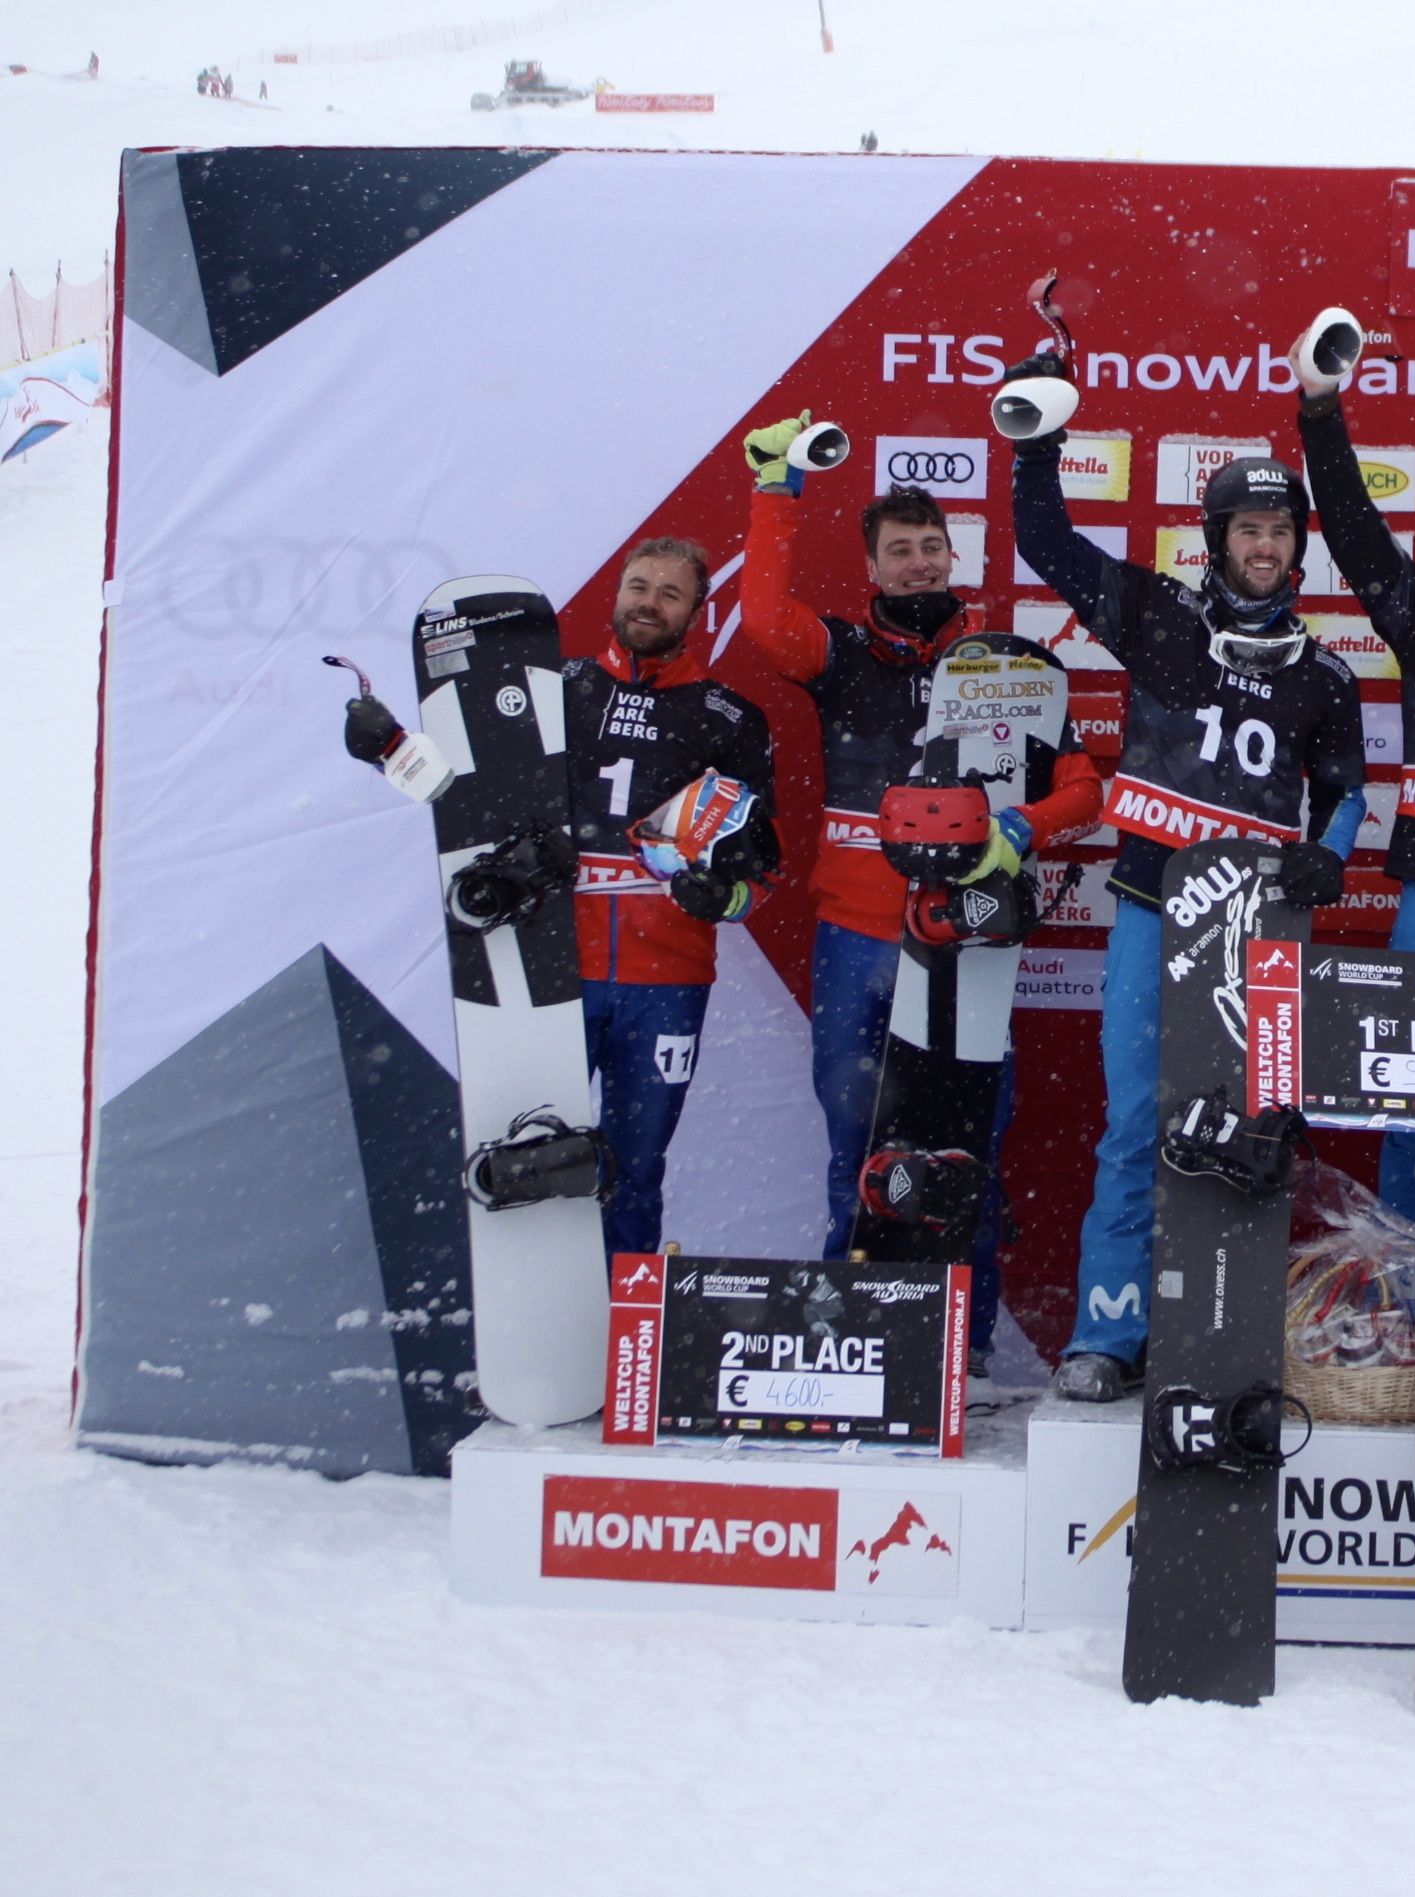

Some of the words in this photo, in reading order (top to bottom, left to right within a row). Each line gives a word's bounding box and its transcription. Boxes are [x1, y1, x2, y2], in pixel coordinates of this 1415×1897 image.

[882, 333, 1005, 385] FIS
[436, 616, 468, 634] LINS
[616, 691, 656, 709] VOR
[1227, 671, 1273, 699] BERG
[612, 706, 648, 723] ARL
[608, 720, 659, 741] BERG
[1195, 704, 1276, 777] 10
[599, 756, 635, 816] 1
[693, 806, 721, 842] SMITH
[1017, 959, 1064, 975] Audi
[1338, 961, 1403, 975] SNOWBOARD
[1338, 970, 1367, 979] WORLD
[1368, 972, 1384, 981] CUP
[1015, 980, 1094, 997] quattro
[1359, 1016, 1400, 1050] 1ST
[659, 1046, 692, 1073] 11
[1257, 1016, 1274, 1108] WELTCUP
[702, 1274, 770, 1287] SNOWBOARD
[703, 1283, 731, 1292] WORLD
[733, 1284, 750, 1292] CUP
[1213, 1248, 1227, 1330] www.oxess.ch
[720, 1331, 770, 1369] 2ND
[771, 1335, 885, 1374] PLACE
[949, 1289, 967, 1437] WELTCUP-MONTAFON.AT
[613, 1336, 632, 1433] WELTCUP
[632, 1319, 655, 1434] MONTAFON
[553, 1510, 821, 1559] MONTAFON
